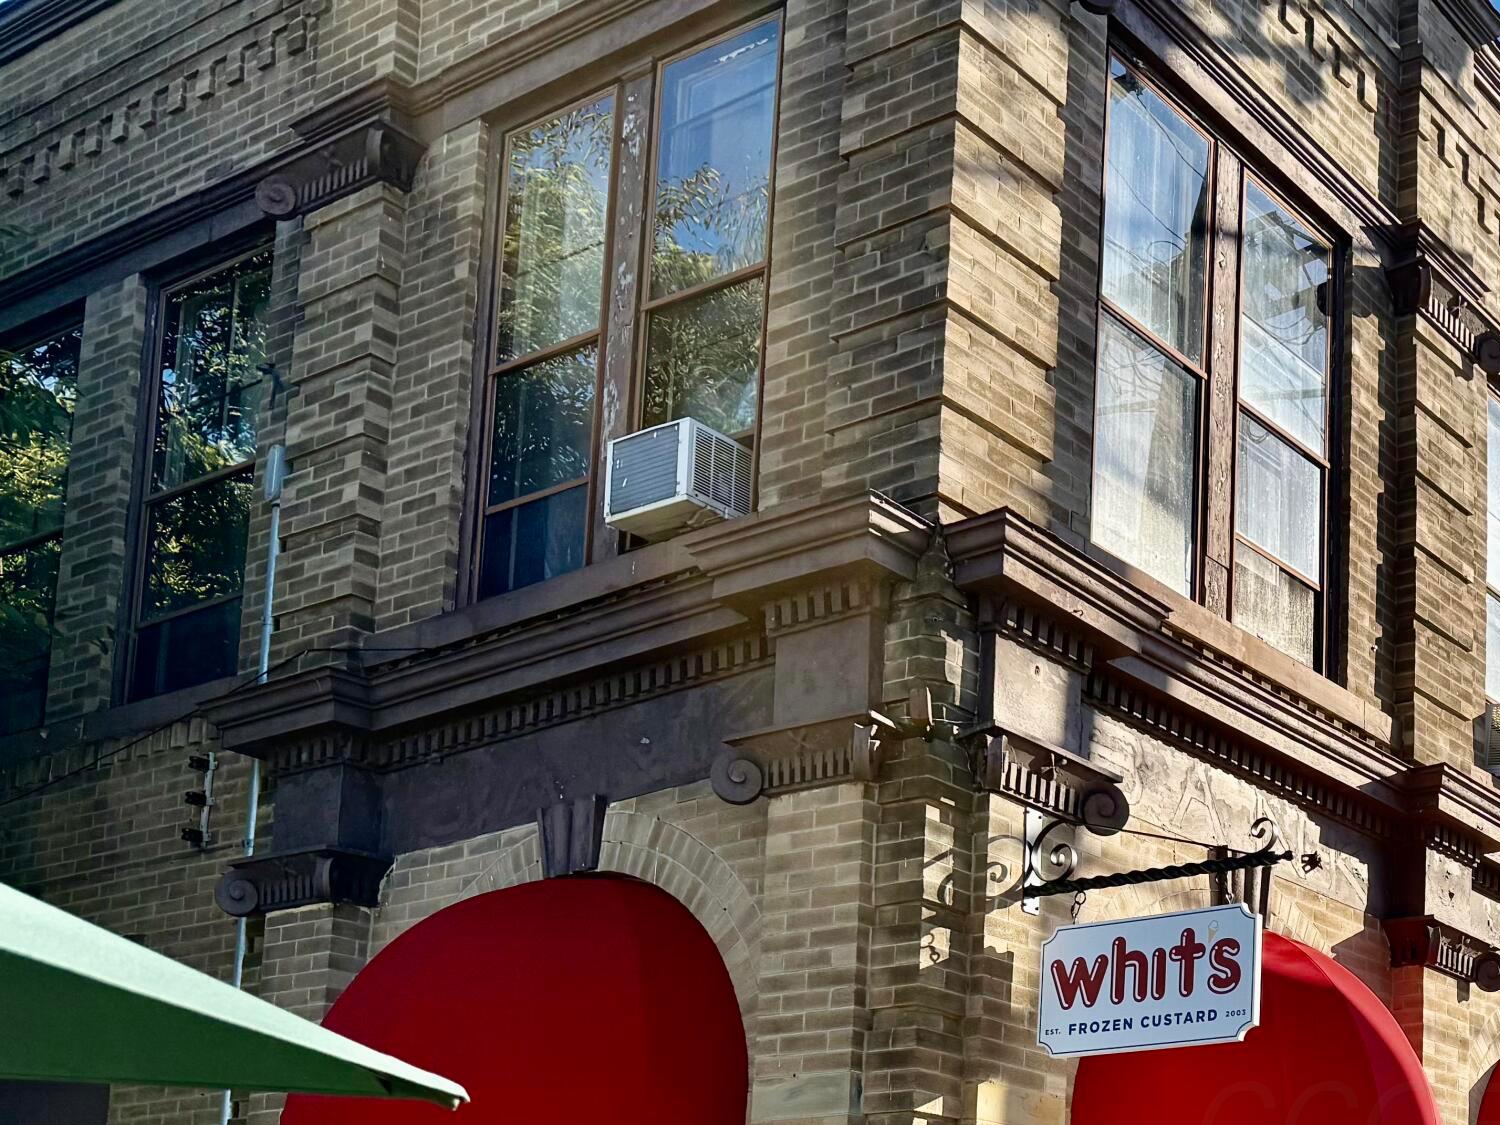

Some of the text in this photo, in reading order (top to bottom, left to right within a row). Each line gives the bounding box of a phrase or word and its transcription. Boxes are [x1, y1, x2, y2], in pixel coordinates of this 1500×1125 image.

[1068, 1017, 1133, 1036] FROZEN
[1140, 1009, 1218, 1028] CUSTARD
[1225, 1008, 1247, 1018] 2003
